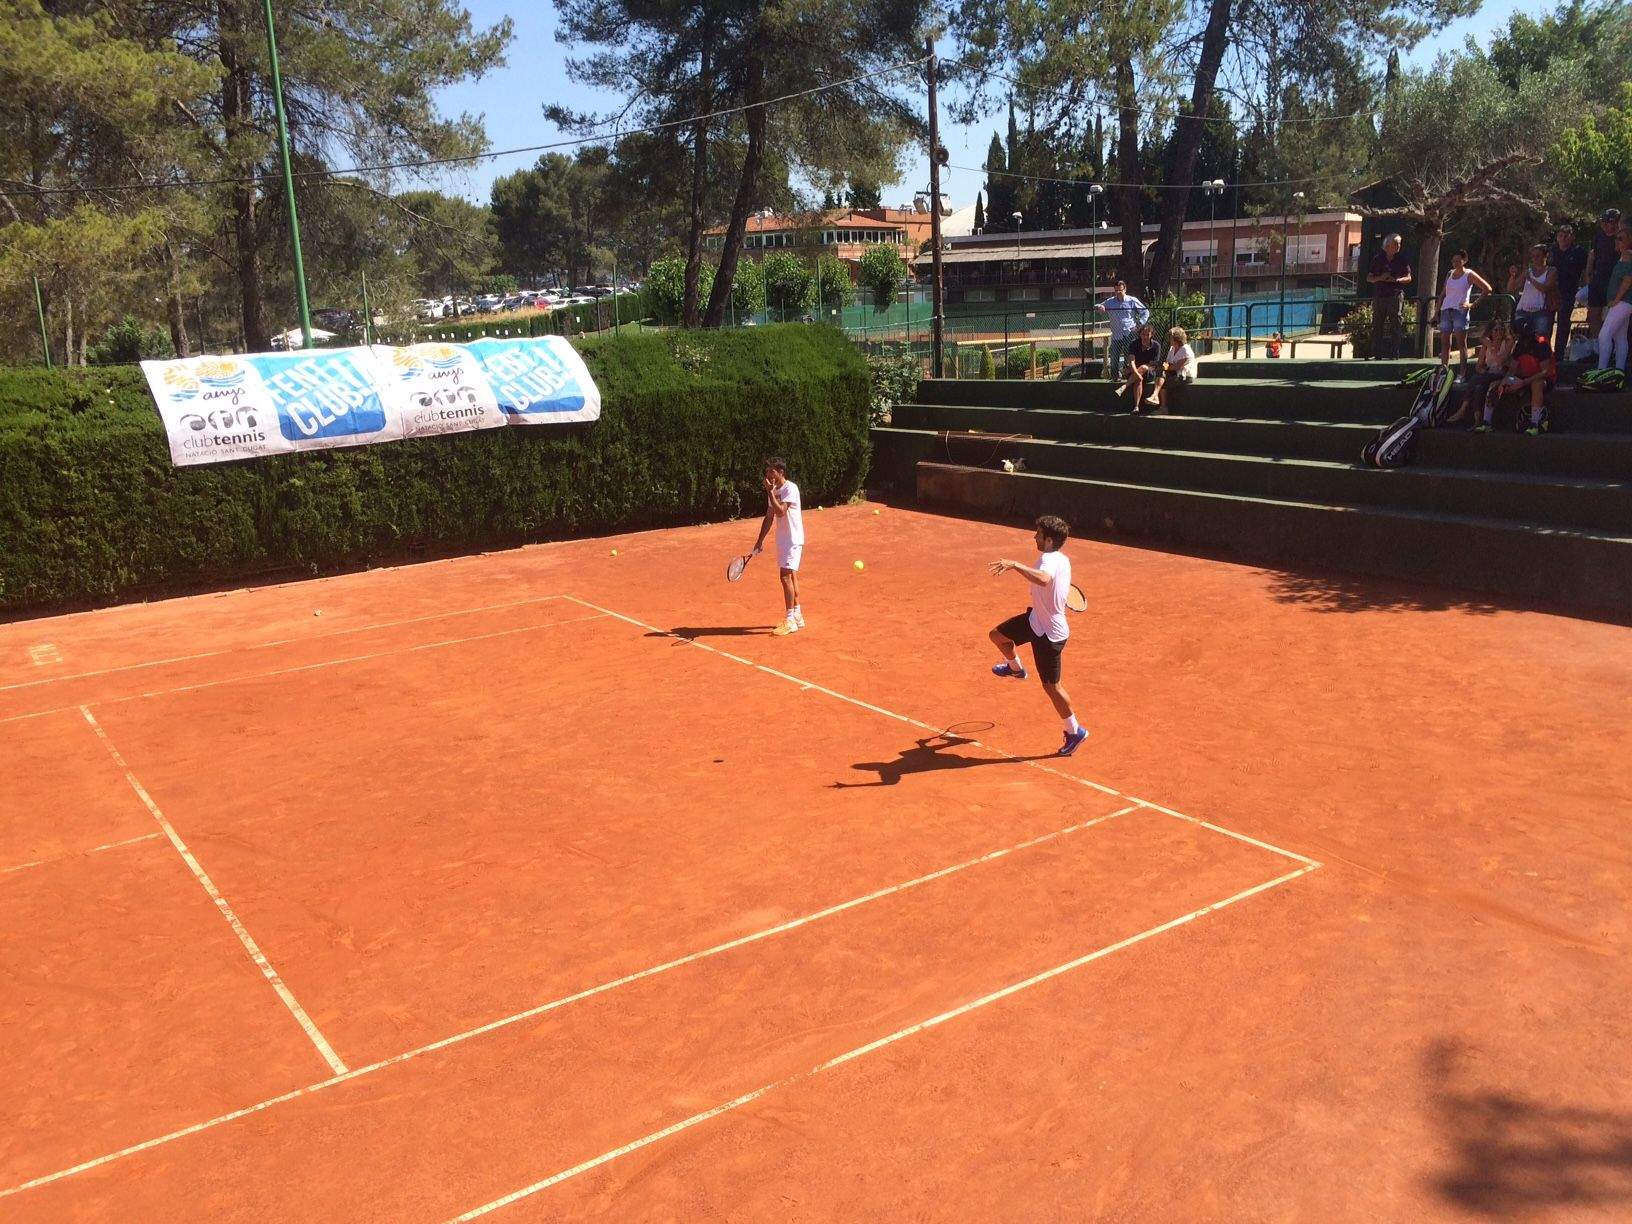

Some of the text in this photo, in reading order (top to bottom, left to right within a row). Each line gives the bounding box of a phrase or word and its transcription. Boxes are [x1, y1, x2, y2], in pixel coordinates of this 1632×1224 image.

[414, 404, 485, 425] clubtennis
[183, 429, 266, 450] clubtennis
[1386, 430, 1413, 461] HEAD
